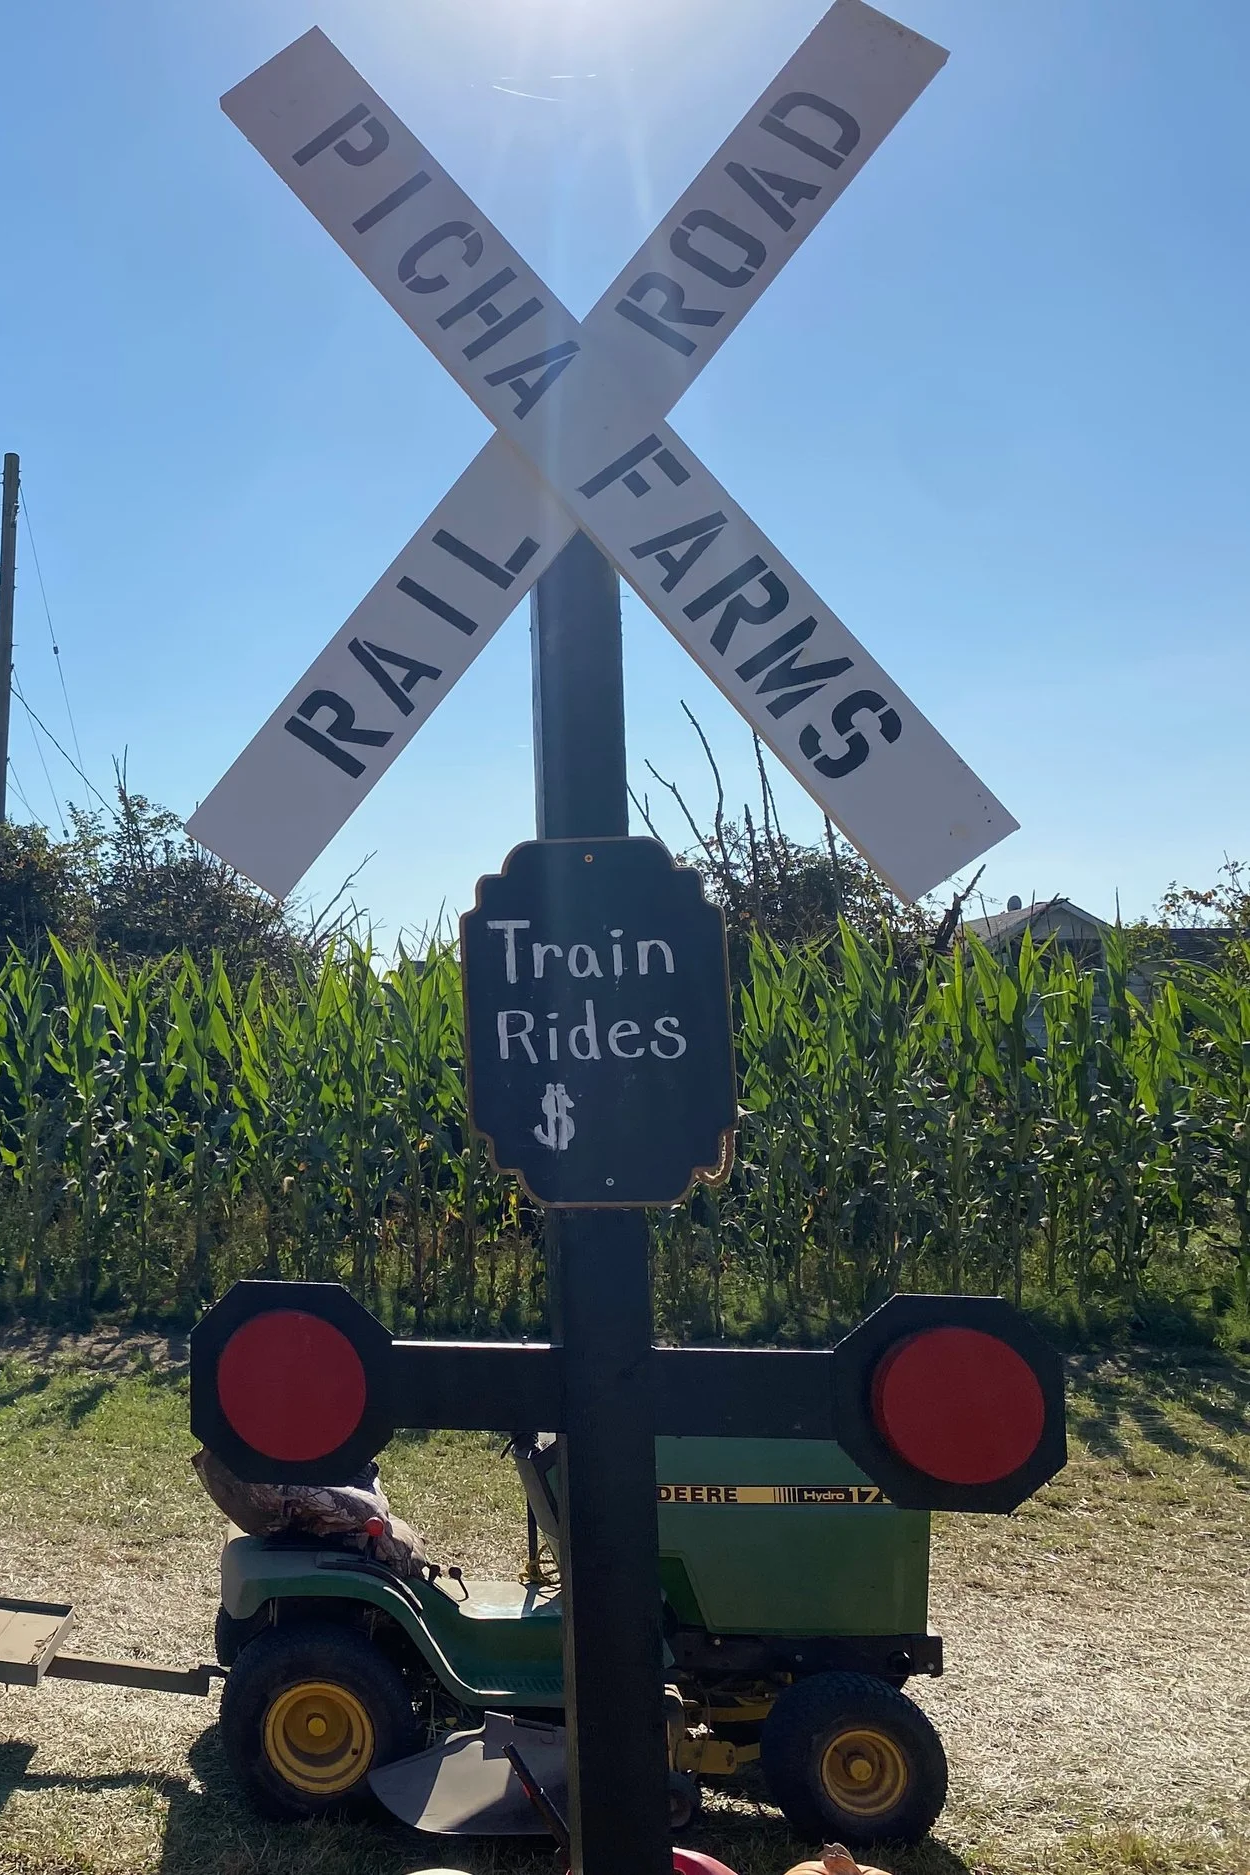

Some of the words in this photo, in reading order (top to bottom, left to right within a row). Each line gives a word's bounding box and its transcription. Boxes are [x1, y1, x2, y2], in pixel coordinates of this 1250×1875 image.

[283, 528, 541, 779] RAIL
[614, 90, 861, 357] ROAD
[291, 103, 581, 419] PICHA
[577, 433, 902, 779] FARMS
[487, 920, 675, 983] Train
[497, 1000, 687, 1063] Rides
[534, 1083, 575, 1150] $
[657, 1486, 737, 1502] DEERE
[803, 1490, 845, 1502] Hydro
